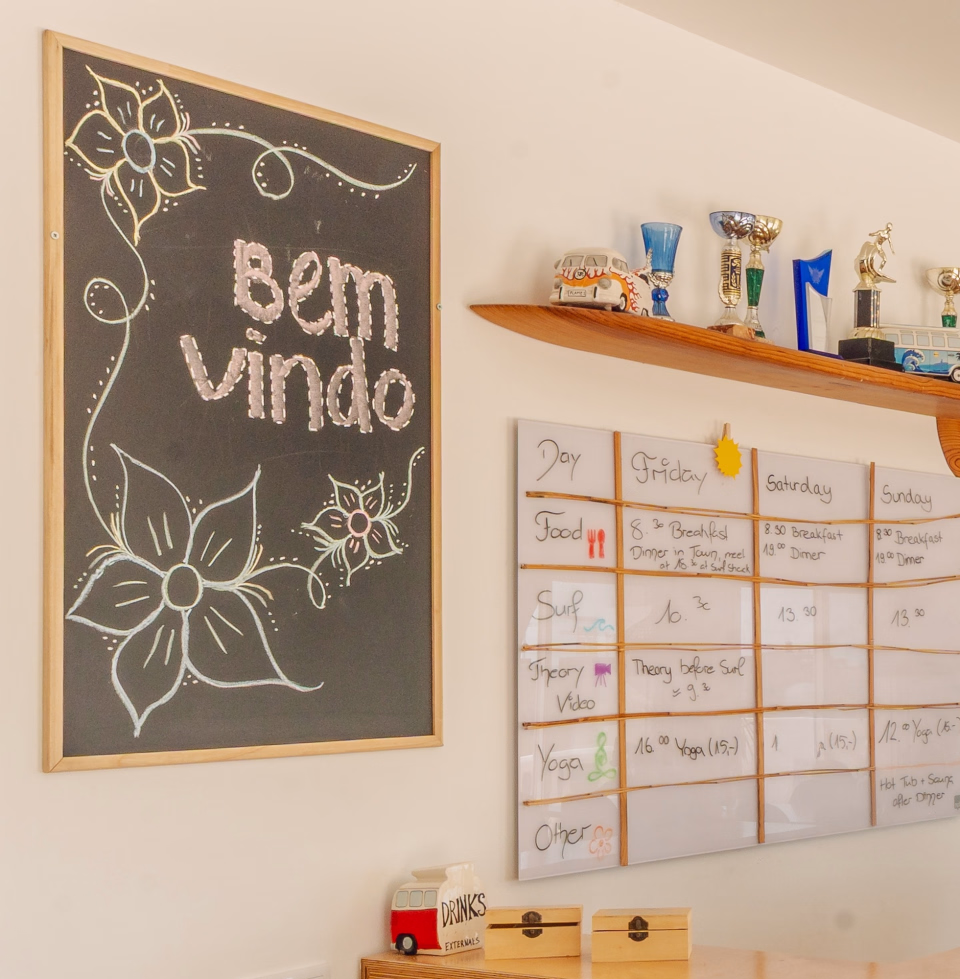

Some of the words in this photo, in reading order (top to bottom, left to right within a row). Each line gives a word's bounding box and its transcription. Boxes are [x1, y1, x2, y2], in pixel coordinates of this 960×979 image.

[234, 239, 398, 352] Bem
[180, 328, 415, 433] vindo
[536, 439, 581, 481] Day
[631, 451, 707, 494] Friday
[765, 474, 832, 504] Saturday
[880, 484, 933, 513] Sunday
[534, 510, 583, 542] Food
[668, 520, 728, 544] Breakfast
[791, 525, 844, 542] Breakfast
[895, 530, 944, 549] Breakfast
[629, 545, 669, 561] Dinner
[673, 547, 684, 556] in
[659, 560, 671, 570] at
[531, 590, 584, 634] Surf
[528, 657, 585, 688] Theory
[632, 658, 673, 684] Theory
[680, 655, 716, 681] before
[719, 656, 746, 677] Surf
[557, 691, 596, 713] Video
[911, 718, 933, 744] Yoga
[537, 742, 584, 782] Yoga
[674, 737, 706, 760] Yoga
[880, 777, 896, 791] Hot
[900, 775, 918, 788] Tub
[892, 793, 912, 808] after
[915, 791, 945, 806] Dinner
[534, 822, 592, 860] Other
[441, 892, 487, 929] DRINKS
